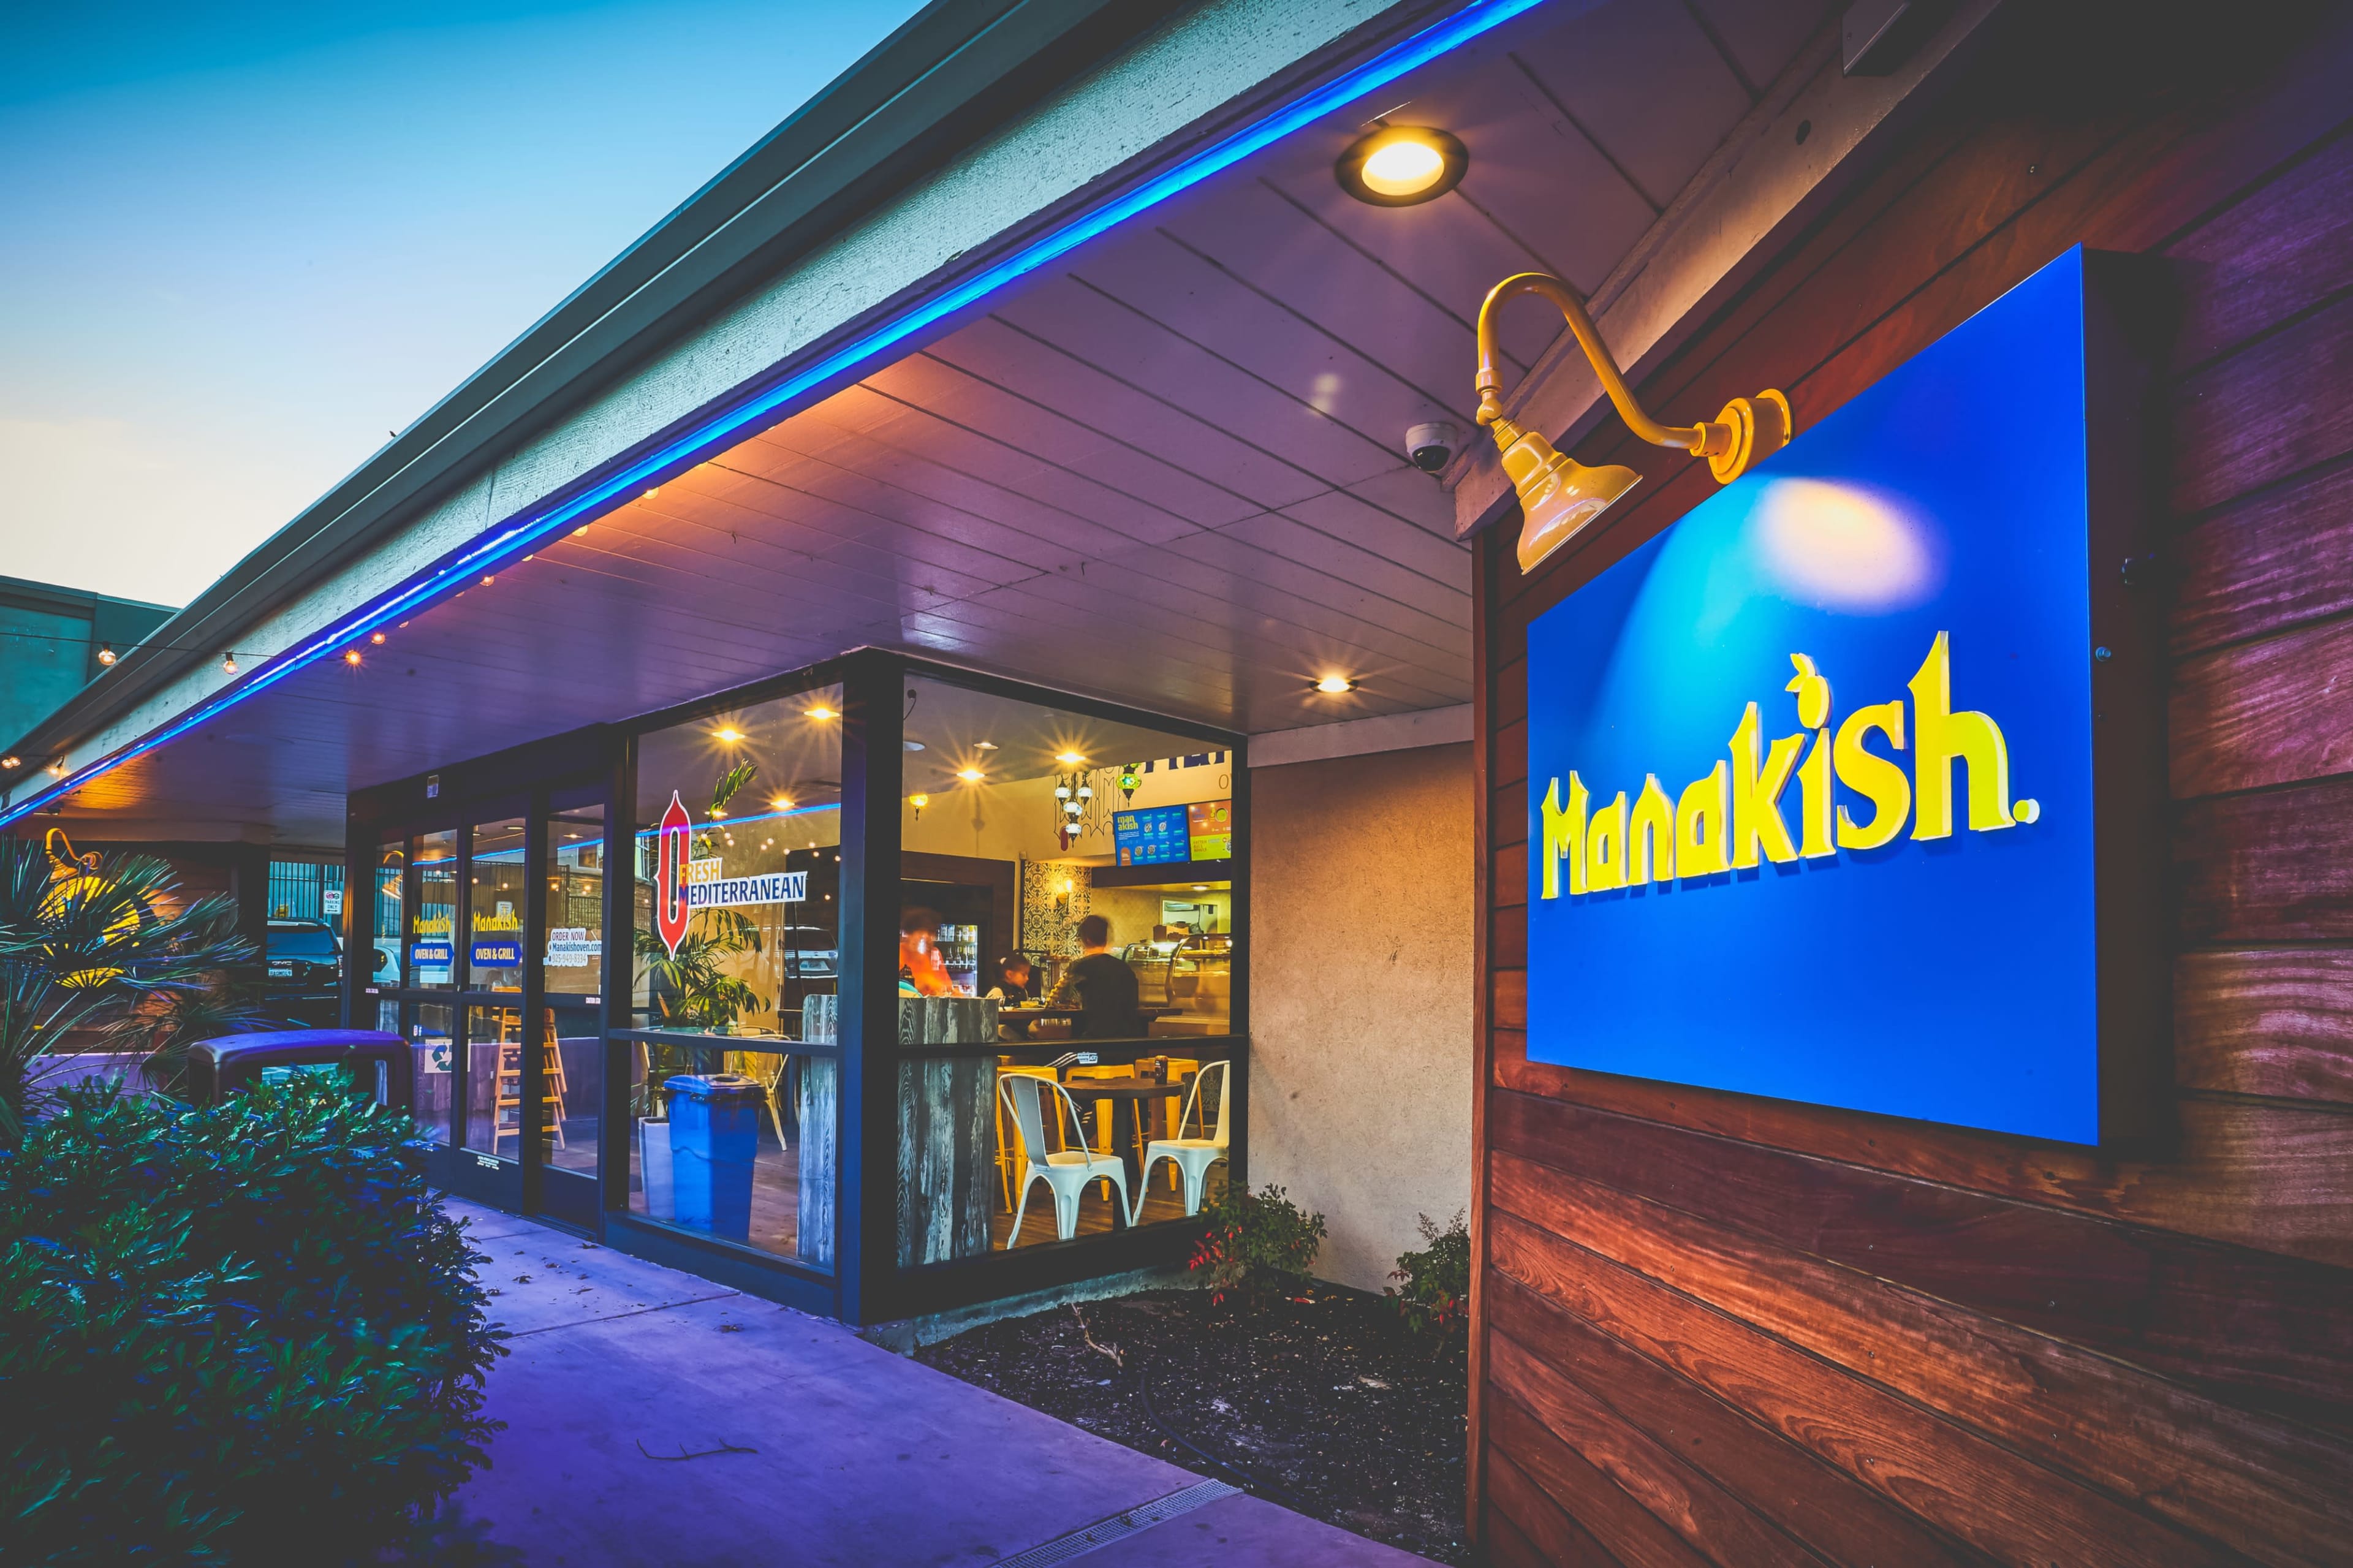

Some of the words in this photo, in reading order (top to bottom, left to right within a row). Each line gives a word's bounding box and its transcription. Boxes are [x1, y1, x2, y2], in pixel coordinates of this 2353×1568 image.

[1540, 629, 2041, 900] Manakish.
[679, 862, 719, 884] FRESH
[679, 876, 804, 906] MEDITERRANEAN
[552, 932, 569, 941] ORDER
[571, 931, 585, 941] NOW
[415, 949, 429, 960] OVEN
[429, 949, 434, 960] &
[434, 949, 449, 960] GRILL
[476, 949, 491, 960] OVEN
[492, 949, 498, 960] &
[498, 948, 515, 960] GRILL
